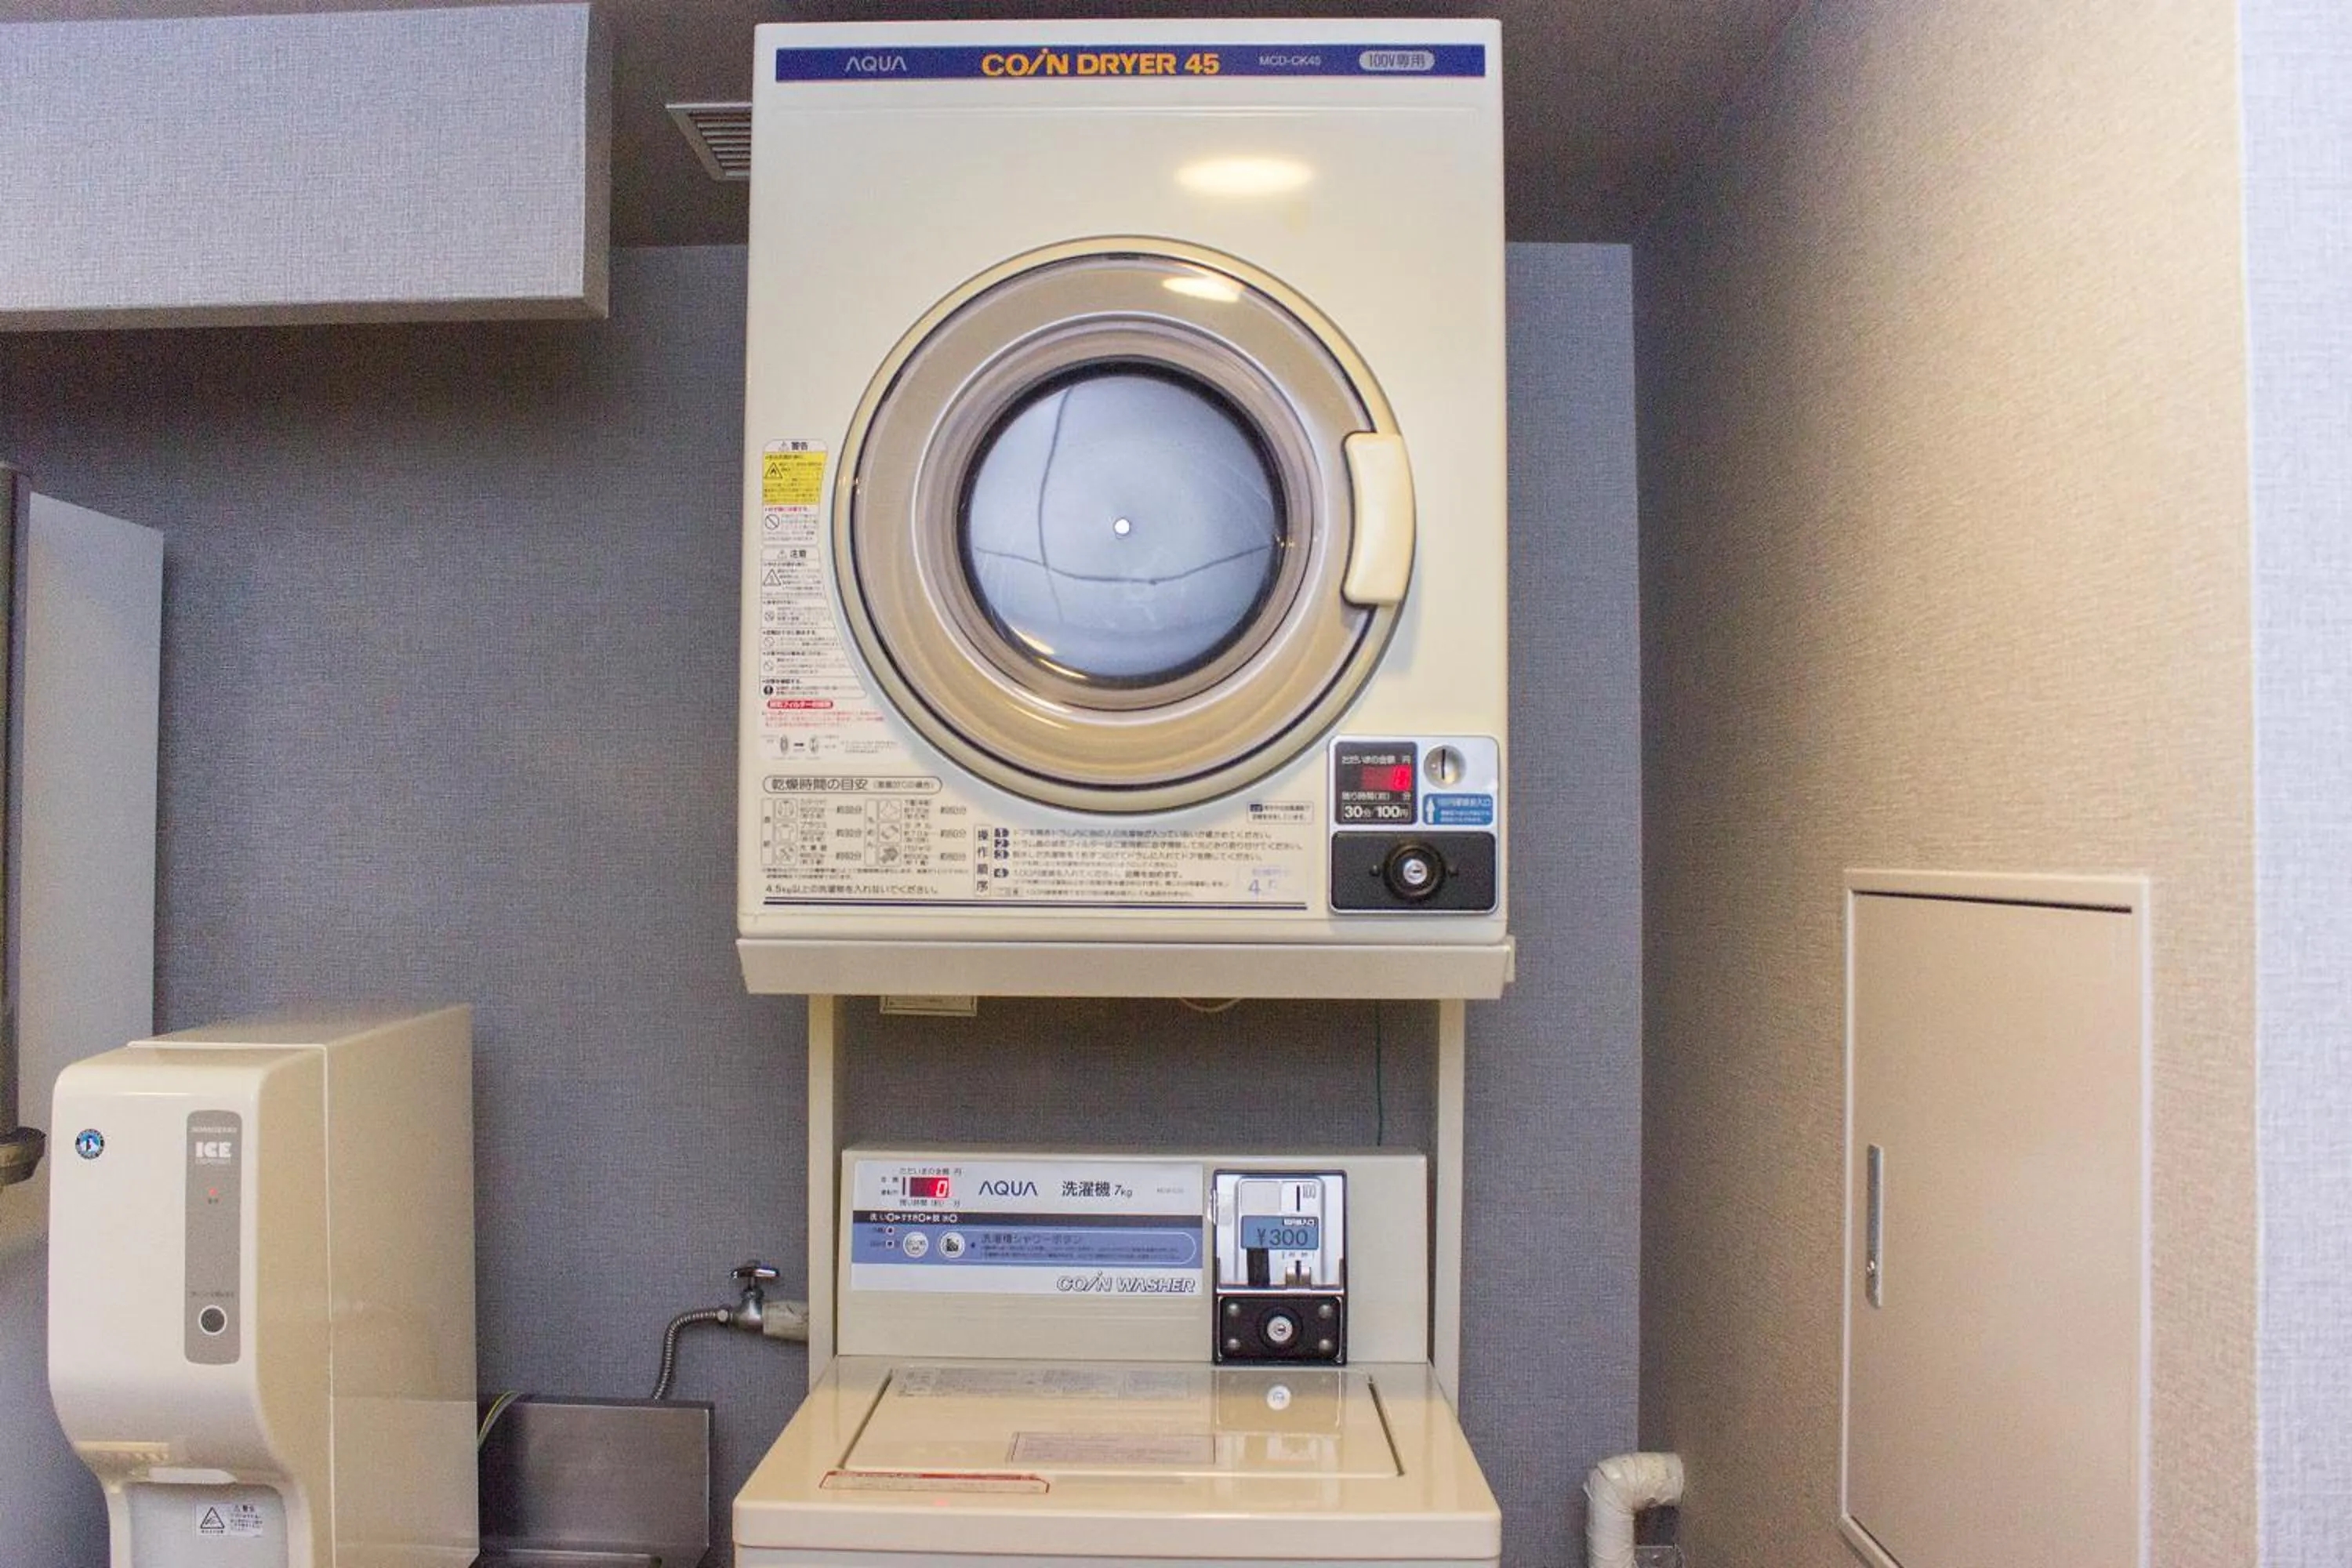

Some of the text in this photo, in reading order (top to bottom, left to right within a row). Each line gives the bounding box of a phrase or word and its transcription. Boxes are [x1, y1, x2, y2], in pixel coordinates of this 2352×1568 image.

[845, 56, 906, 71] AQUA
[982, 48, 1221, 76] COIN DRYER 45
[195, 1141, 232, 1158] ICE
[935, 1180, 949, 1197] 0
[978, 1181, 1039, 1196] AQUA
[1062, 1181, 1133, 1198] 洗濯機 7kg
[1056, 1270, 1196, 1293] COIN WASHER
